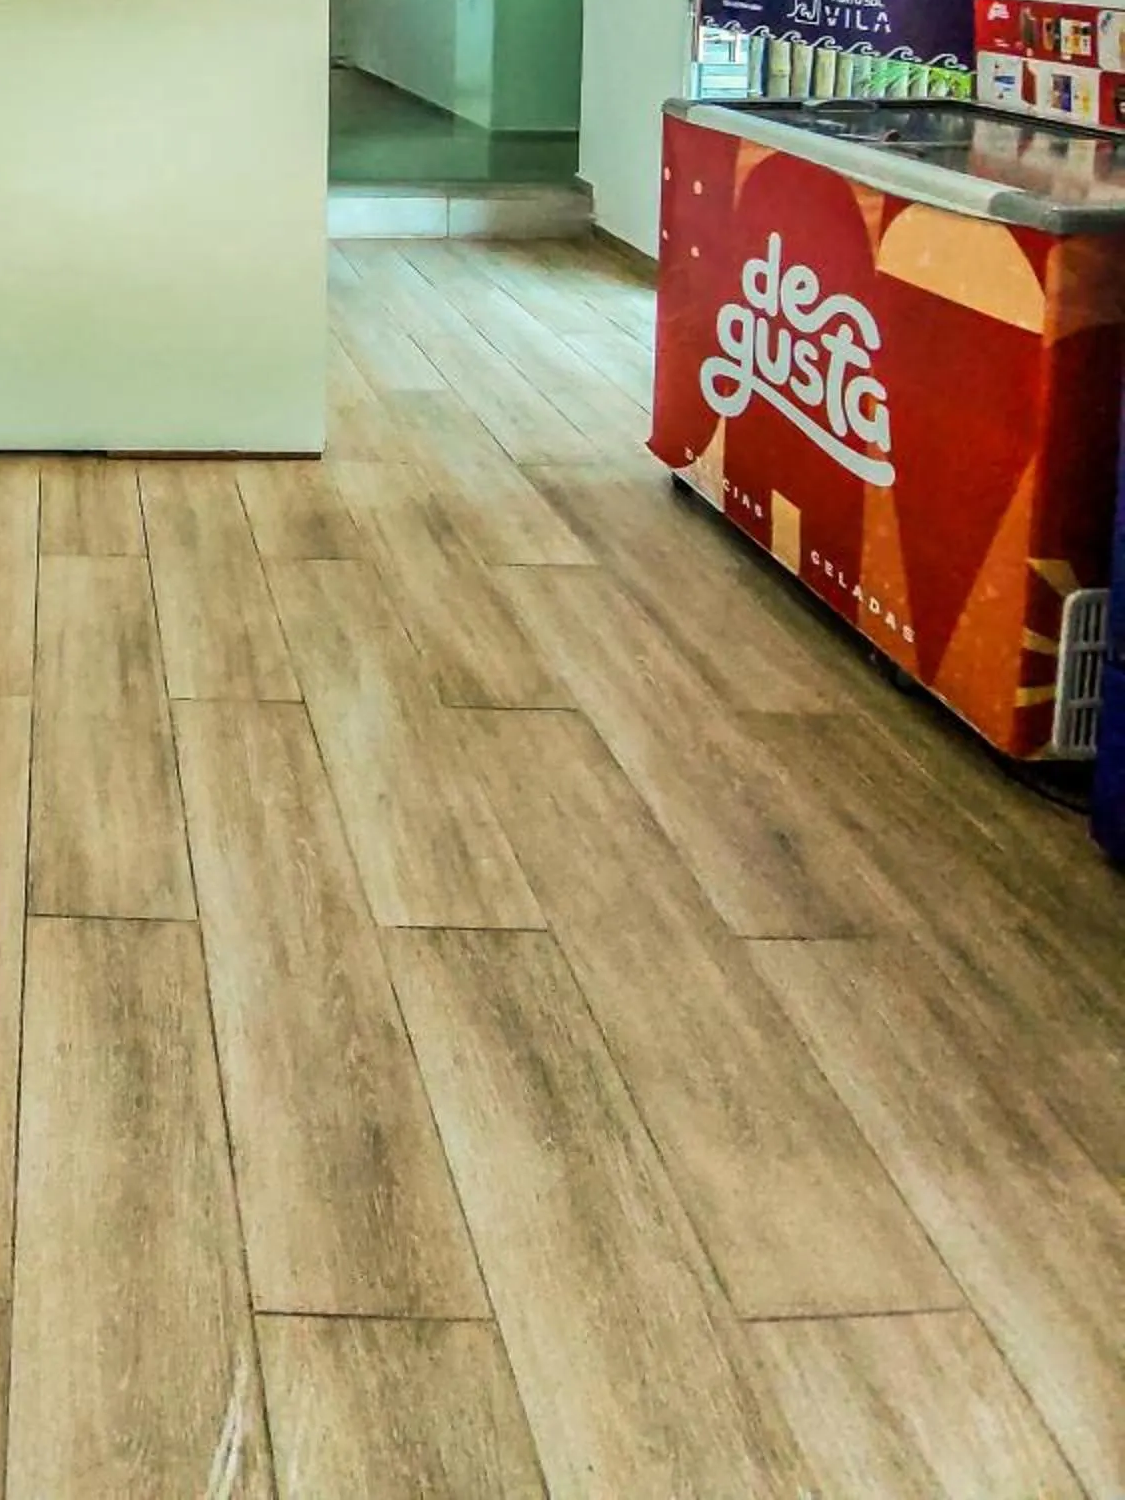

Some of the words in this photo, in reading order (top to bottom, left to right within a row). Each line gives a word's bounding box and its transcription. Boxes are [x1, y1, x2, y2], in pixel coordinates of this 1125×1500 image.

[825, 6, 892, 34] VILA
[742, 231, 882, 350] de
[700, 303, 896, 487] gusta
